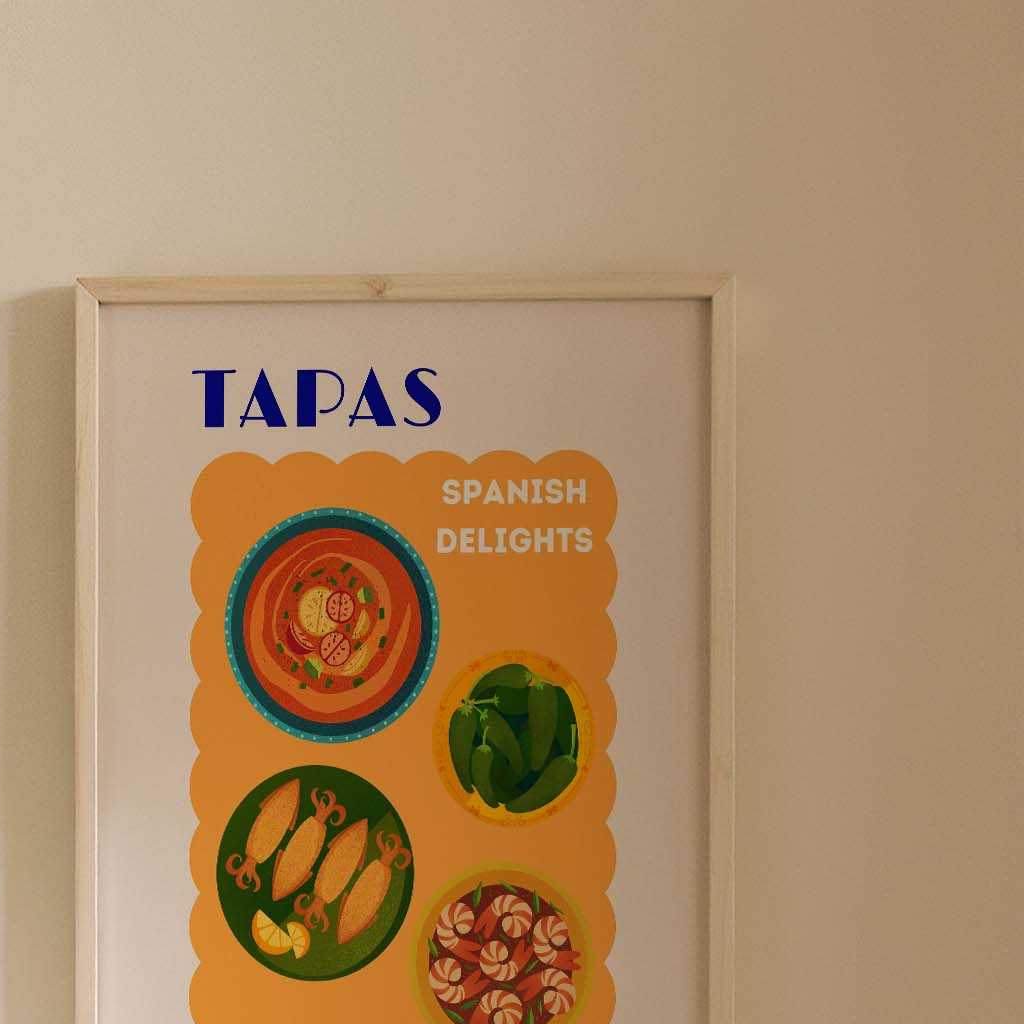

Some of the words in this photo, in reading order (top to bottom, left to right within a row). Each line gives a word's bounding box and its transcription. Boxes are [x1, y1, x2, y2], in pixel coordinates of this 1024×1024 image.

[192, 366, 442, 428] TAPAS
[442, 478, 587, 504] SPANISH
[437, 527, 593, 553] DELIGHTS
